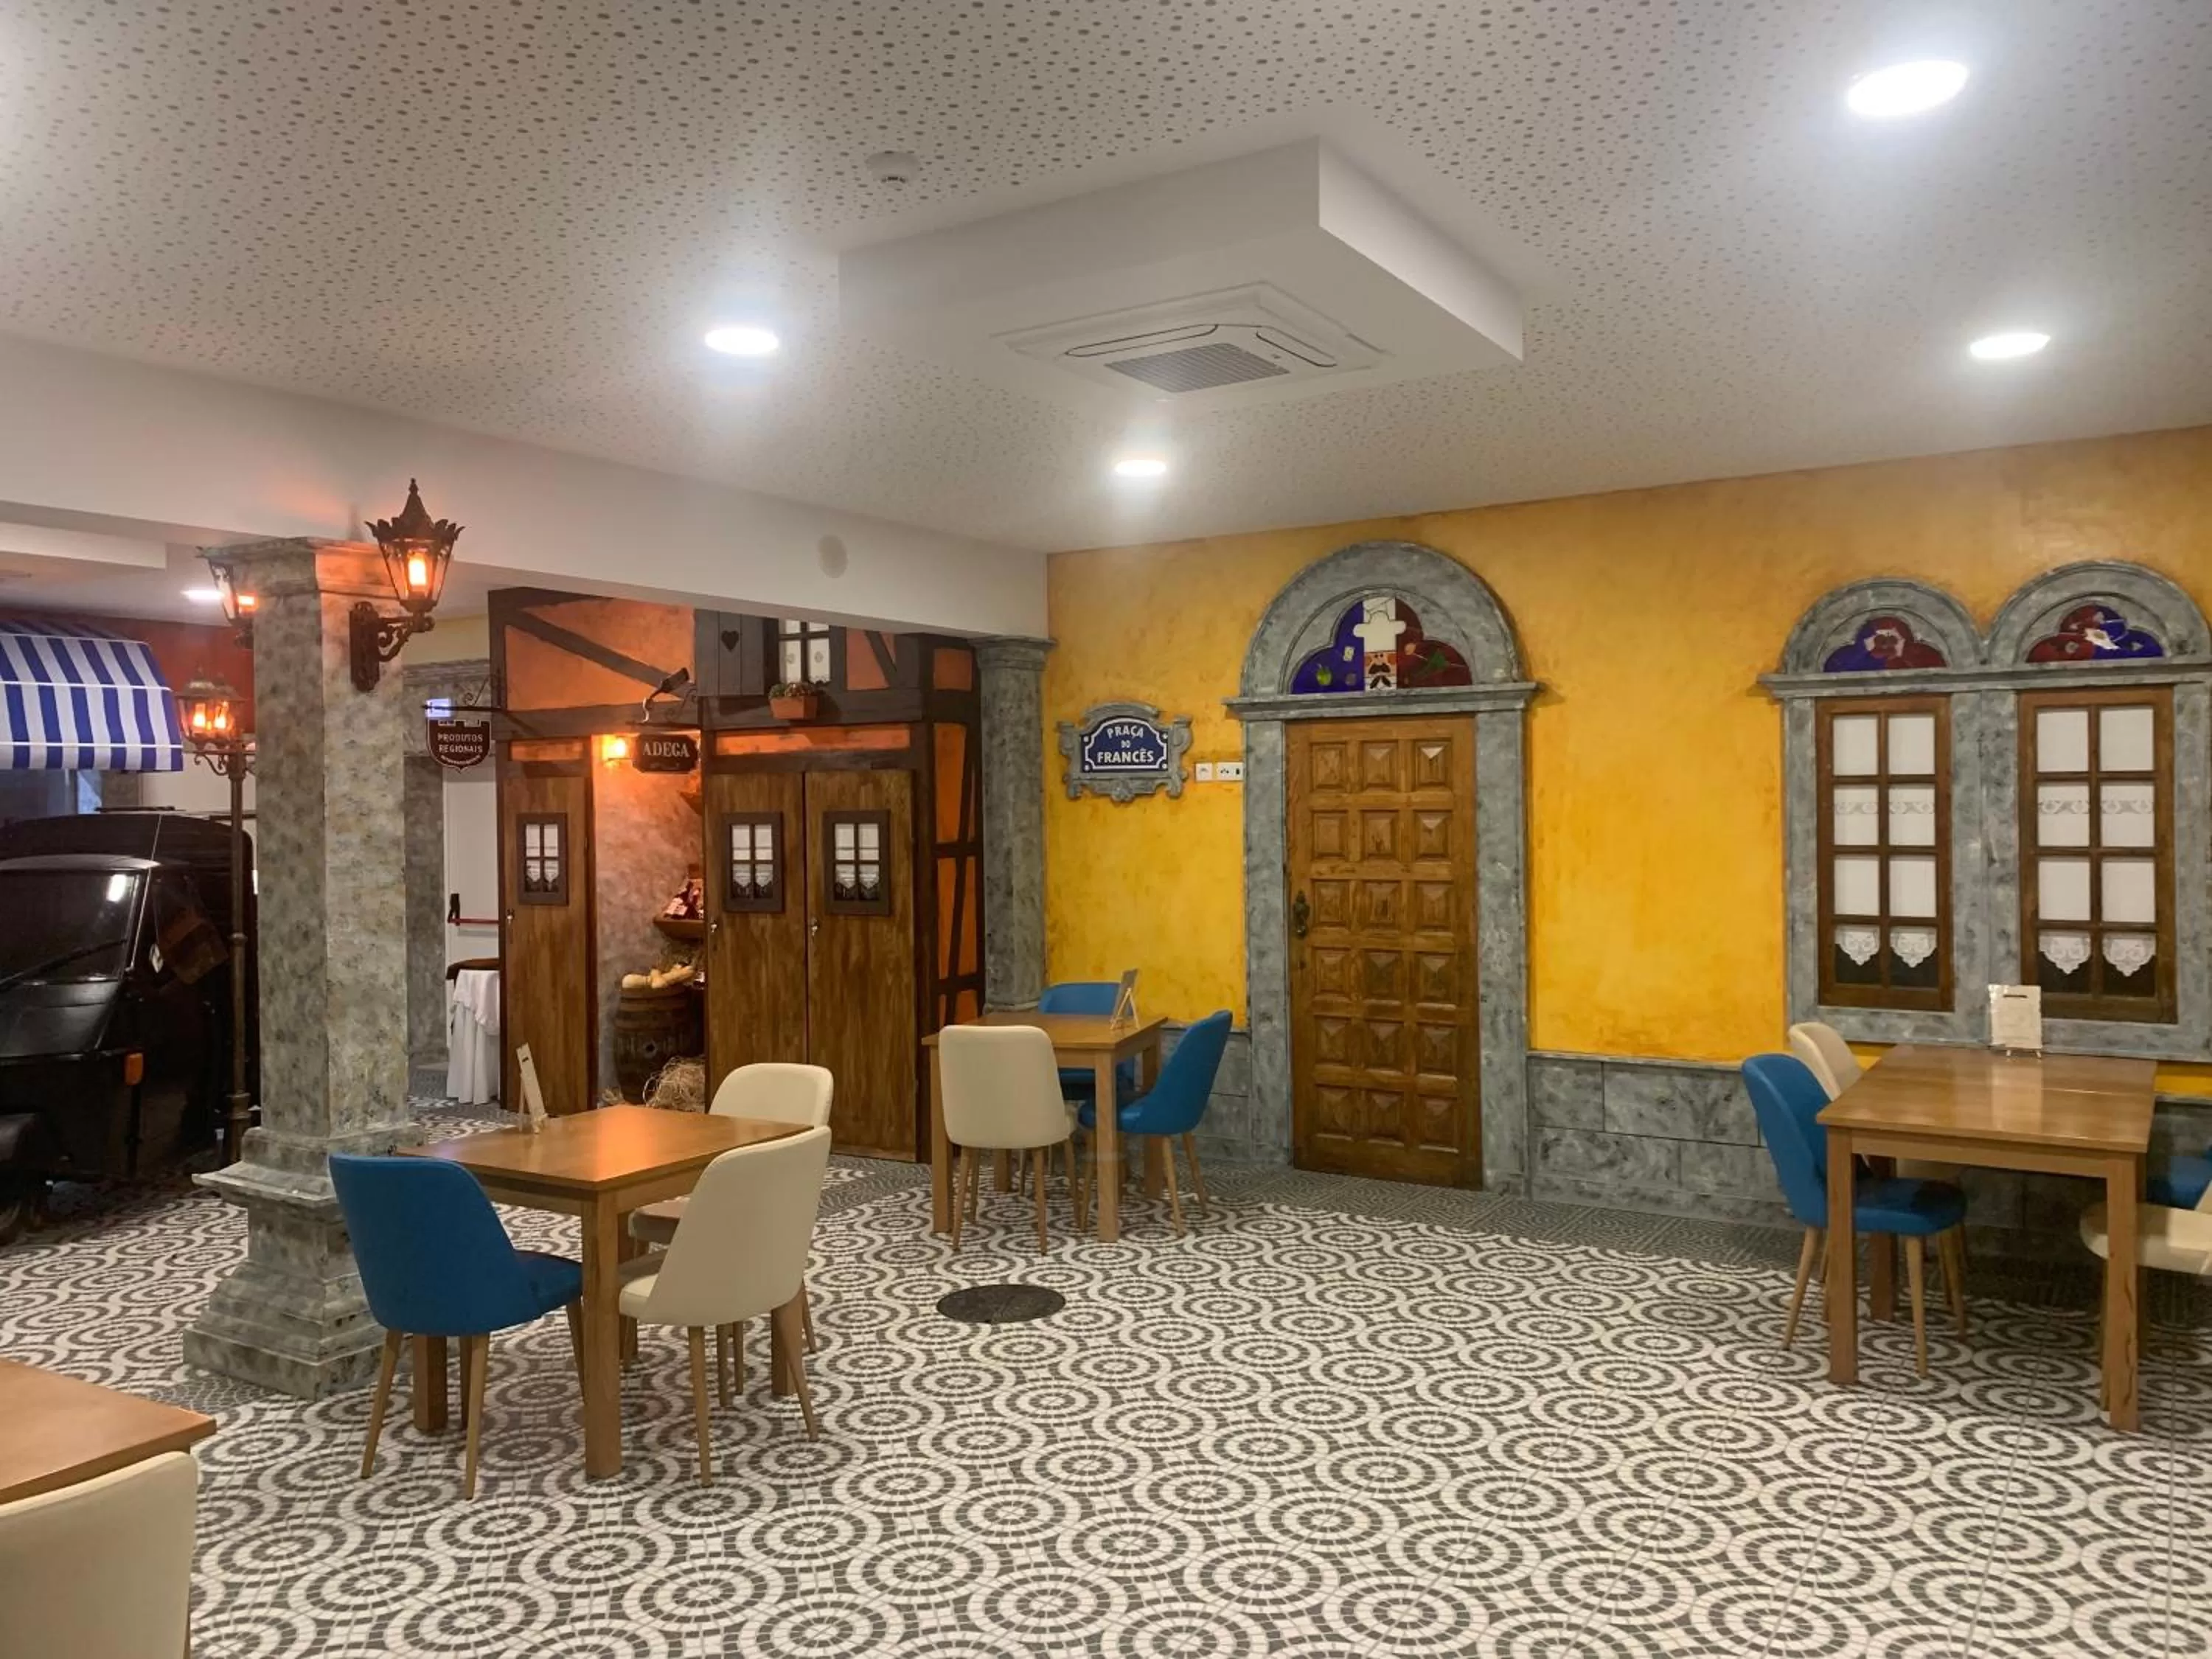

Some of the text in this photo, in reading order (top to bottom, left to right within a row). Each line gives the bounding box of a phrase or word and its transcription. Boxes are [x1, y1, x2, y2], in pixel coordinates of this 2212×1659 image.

[437, 732, 483, 743] PRODUTOS
[1107, 725, 1144, 739] PRAÇA
[642, 741, 691, 758] ADEGA
[1096, 748, 1154, 763] FRANCÊS
